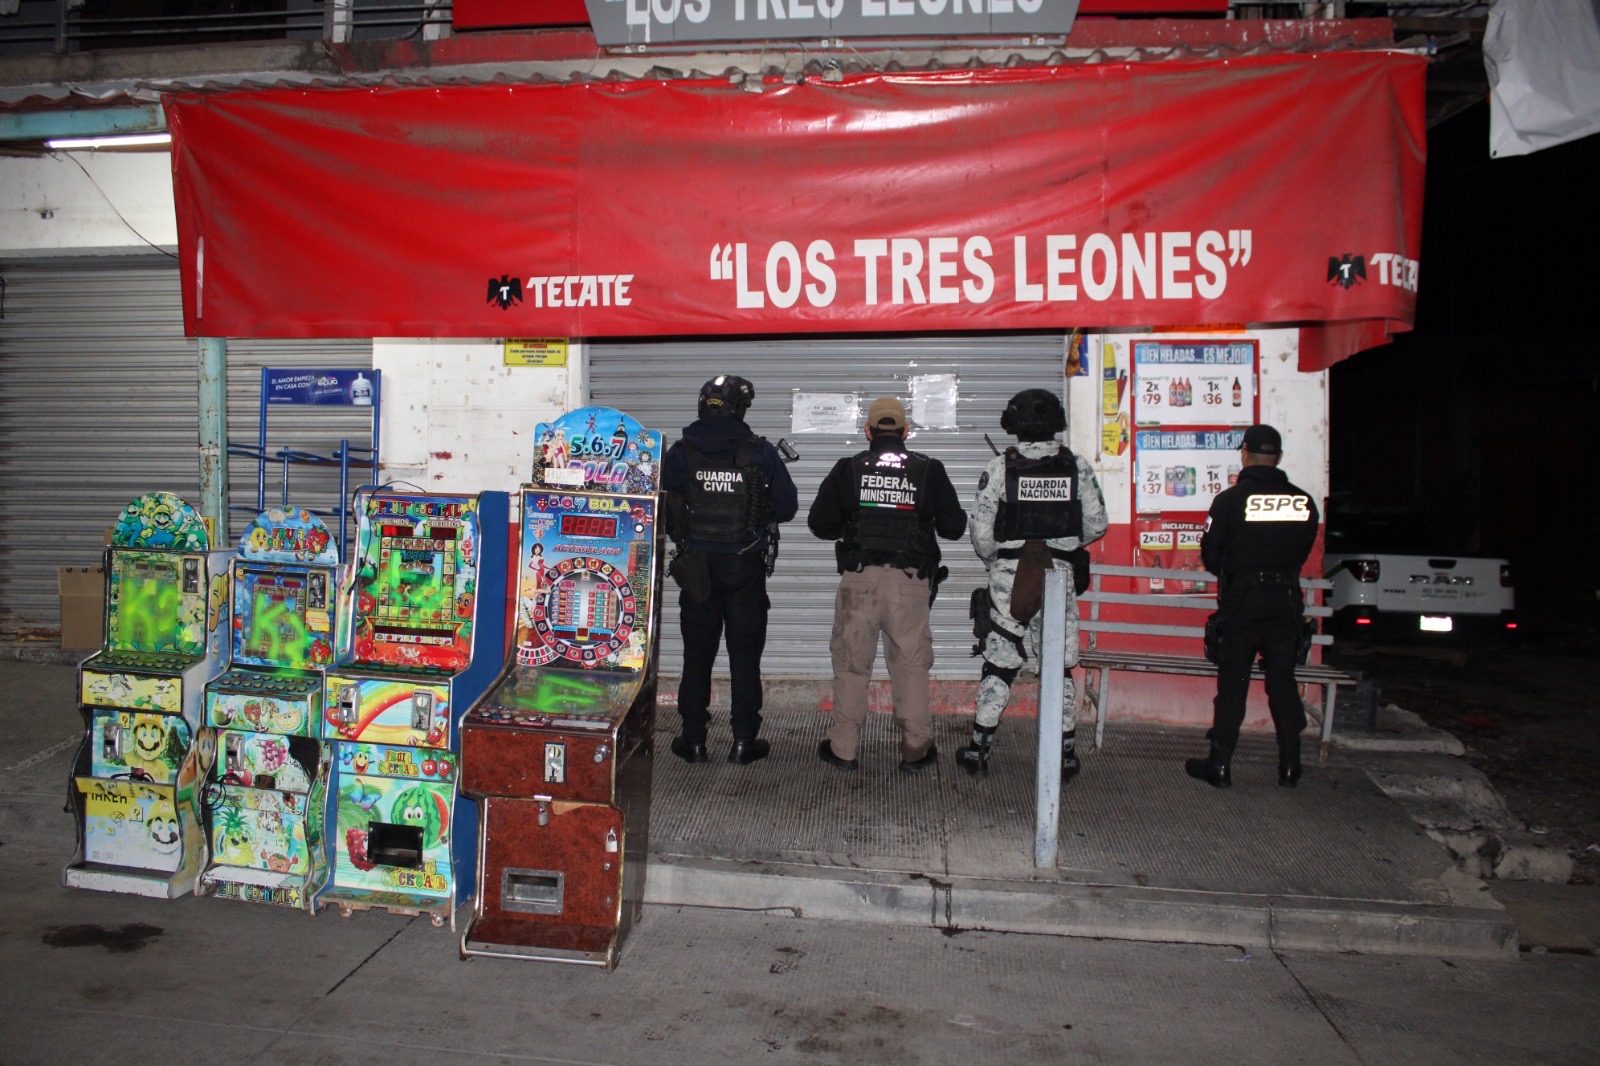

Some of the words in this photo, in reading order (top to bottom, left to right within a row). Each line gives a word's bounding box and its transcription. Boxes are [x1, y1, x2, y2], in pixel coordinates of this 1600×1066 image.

[854, 235, 995, 305] TRES
[526, 274, 635, 308] TECATE
[1141, 348, 1159, 362] BIEN
[1216, 348, 1248, 364] MEJOR
[277, 376, 293, 384] AMOR
[1142, 393, 1161, 405] $79
[1203, 393, 1222, 405] $36
[1143, 434, 1160, 448] BIEN
[696, 470, 743, 483] GUARDIA
[861, 475, 917, 491] FEDERAL
[703, 481, 735, 493] CIVIL
[1020, 480, 1068, 489] GUARDIA
[1142, 483, 1161, 494] $37
[1202, 483, 1222, 494] $19
[860, 489, 916, 505] MINISTERIAL
[1020, 489, 1068, 499] NACIONAL
[377, 500, 412, 517] FRUIT
[588, 497, 632, 512] BOLA
[1248, 497, 1306, 512] SSPC
[379, 517, 410, 526] PREMIOS
[1161, 522, 1195, 530] INCLUYE
[272, 528, 307, 540] FRUIT
[267, 537, 310, 551] COCKTAIL
[552, 543, 623, 556] ACUMULADO
[1410, 574, 1475, 587] RAM
